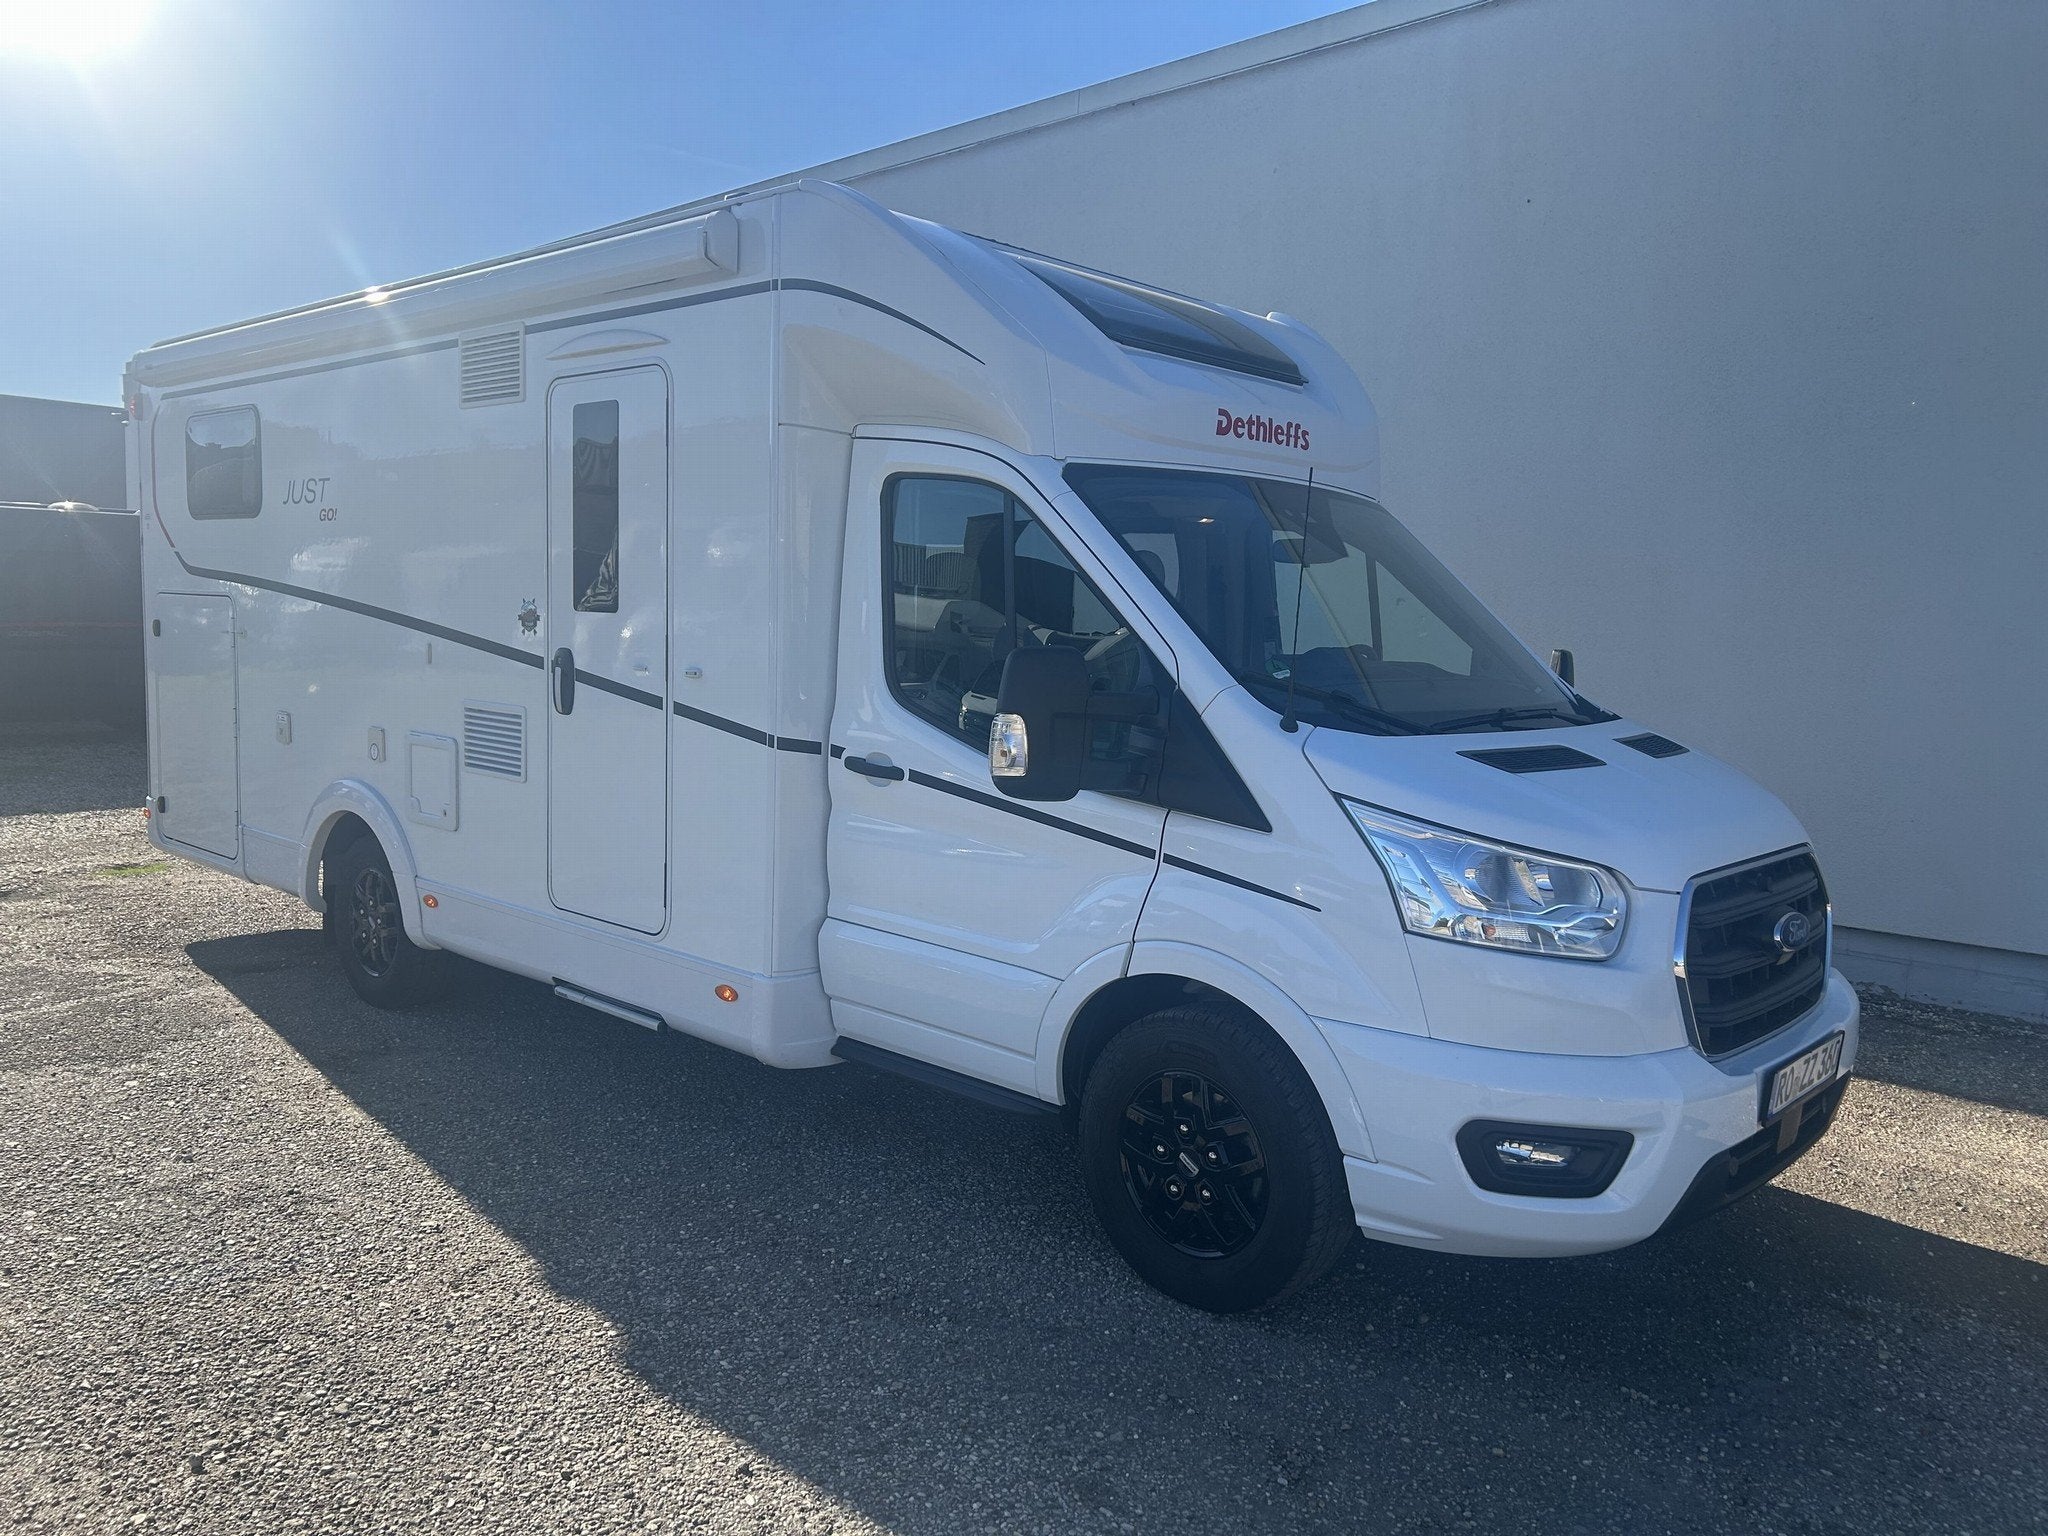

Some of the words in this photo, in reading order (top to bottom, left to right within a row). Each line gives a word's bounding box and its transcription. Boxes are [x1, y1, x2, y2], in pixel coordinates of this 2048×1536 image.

[1215, 407, 1310, 451] Dethleffs
[282, 477, 330, 505] JUST
[319, 507, 338, 521] GO!
[1775, 1066, 1795, 1108] RO
[1799, 1053, 1818, 1093] ZZ
